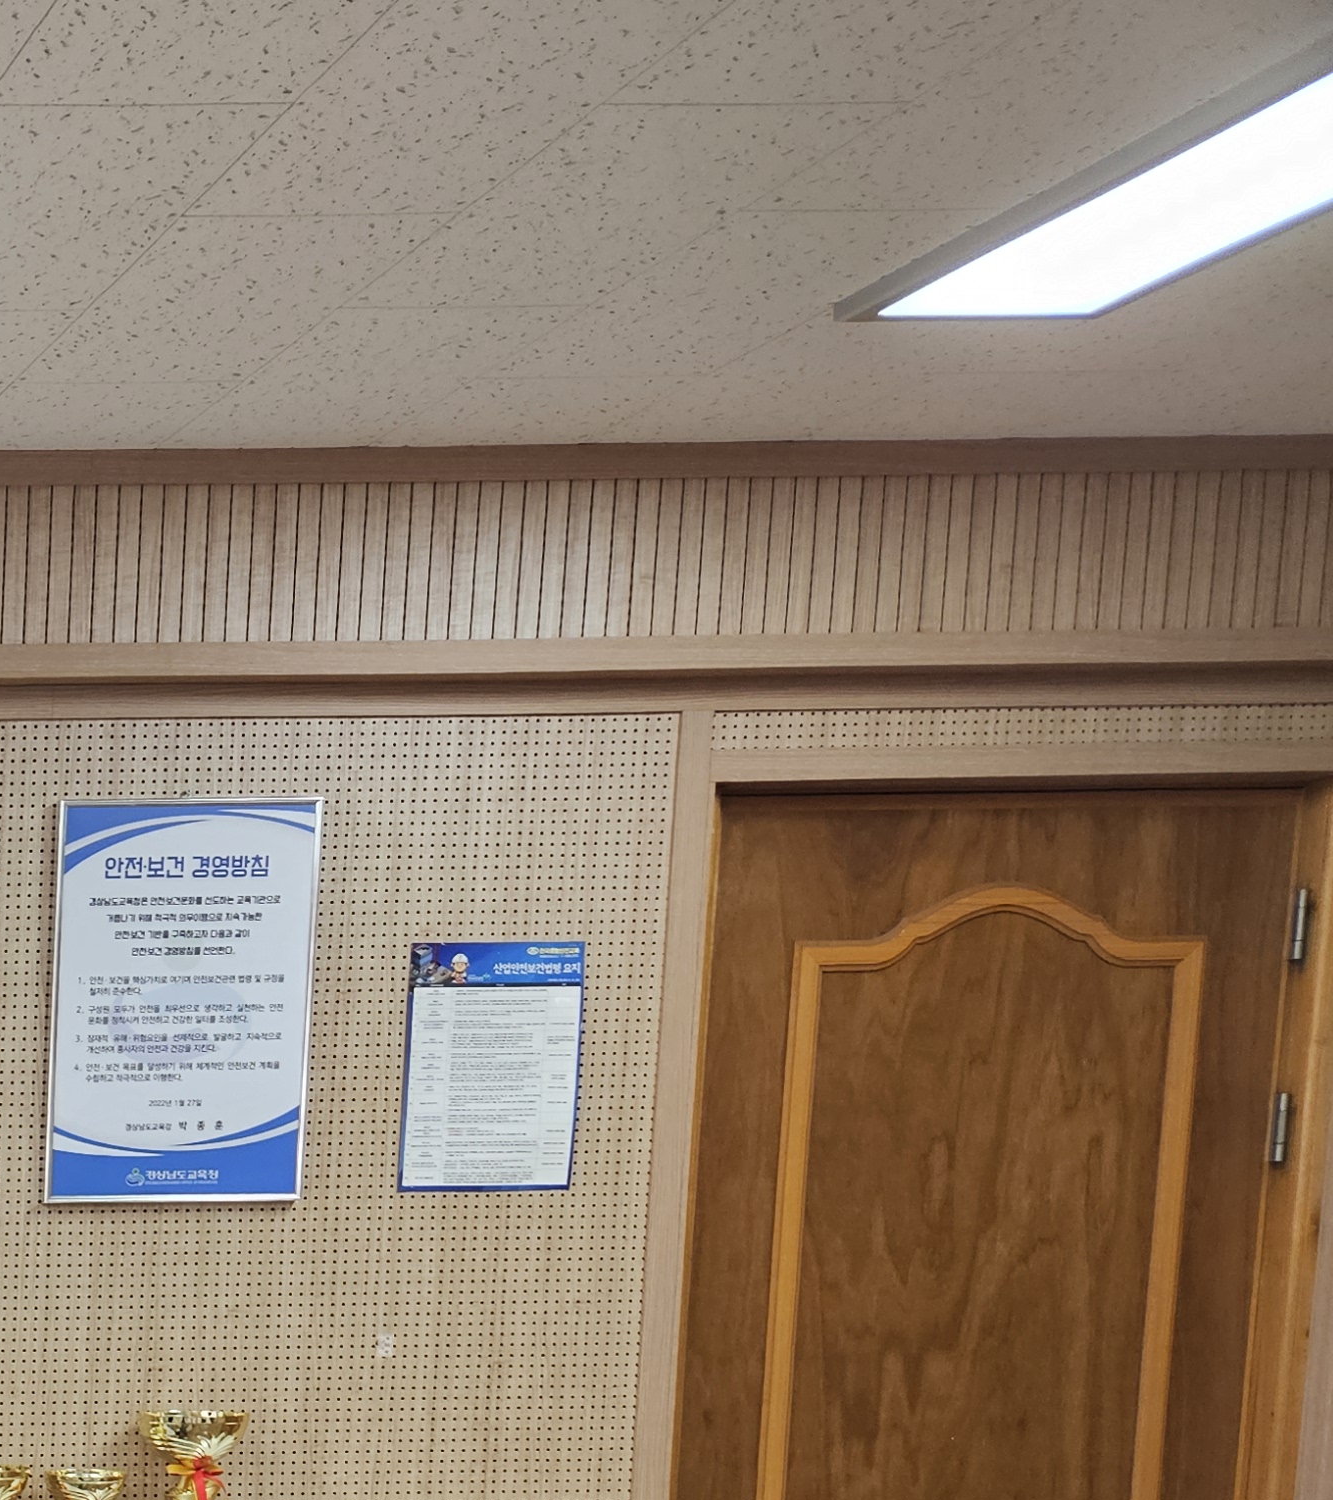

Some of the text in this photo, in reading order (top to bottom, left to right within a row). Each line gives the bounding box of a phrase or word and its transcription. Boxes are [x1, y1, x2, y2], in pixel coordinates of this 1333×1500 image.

[192, 855, 269, 878] 경영방침
[563, 962, 581, 973] 요지
[145, 1170, 219, 1180] 경상남도교육청
